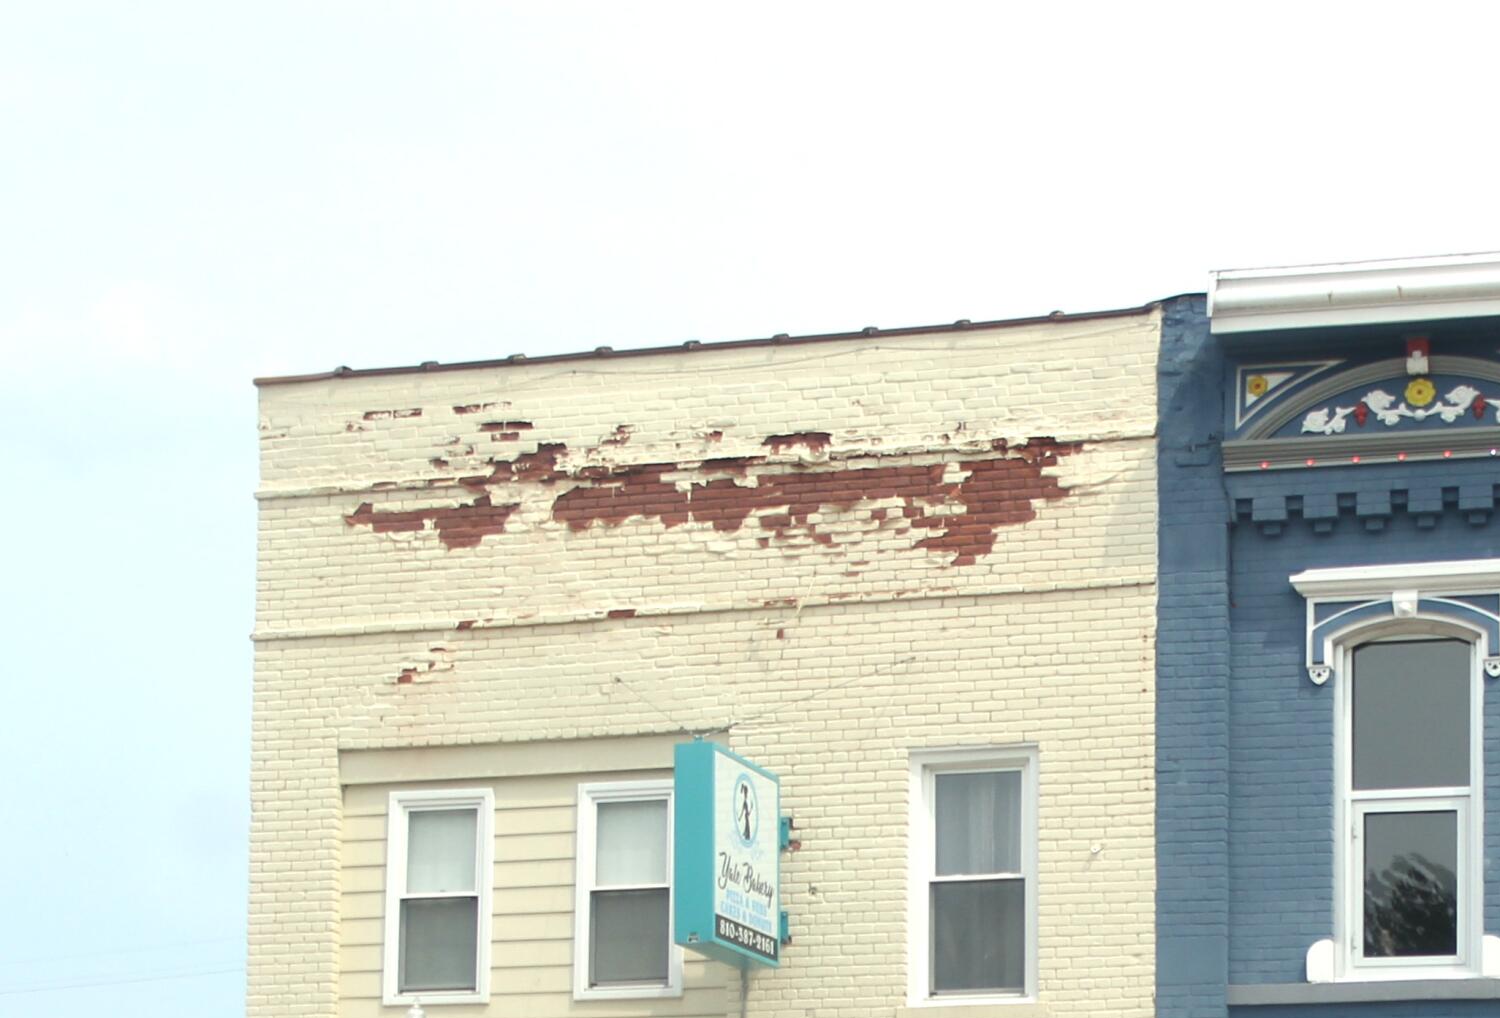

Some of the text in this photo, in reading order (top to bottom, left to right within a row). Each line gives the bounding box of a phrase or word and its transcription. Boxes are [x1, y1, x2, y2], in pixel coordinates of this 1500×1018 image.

[718, 852, 774, 909] Yale Bakery
[719, 918, 775, 956] 810-387-2161
